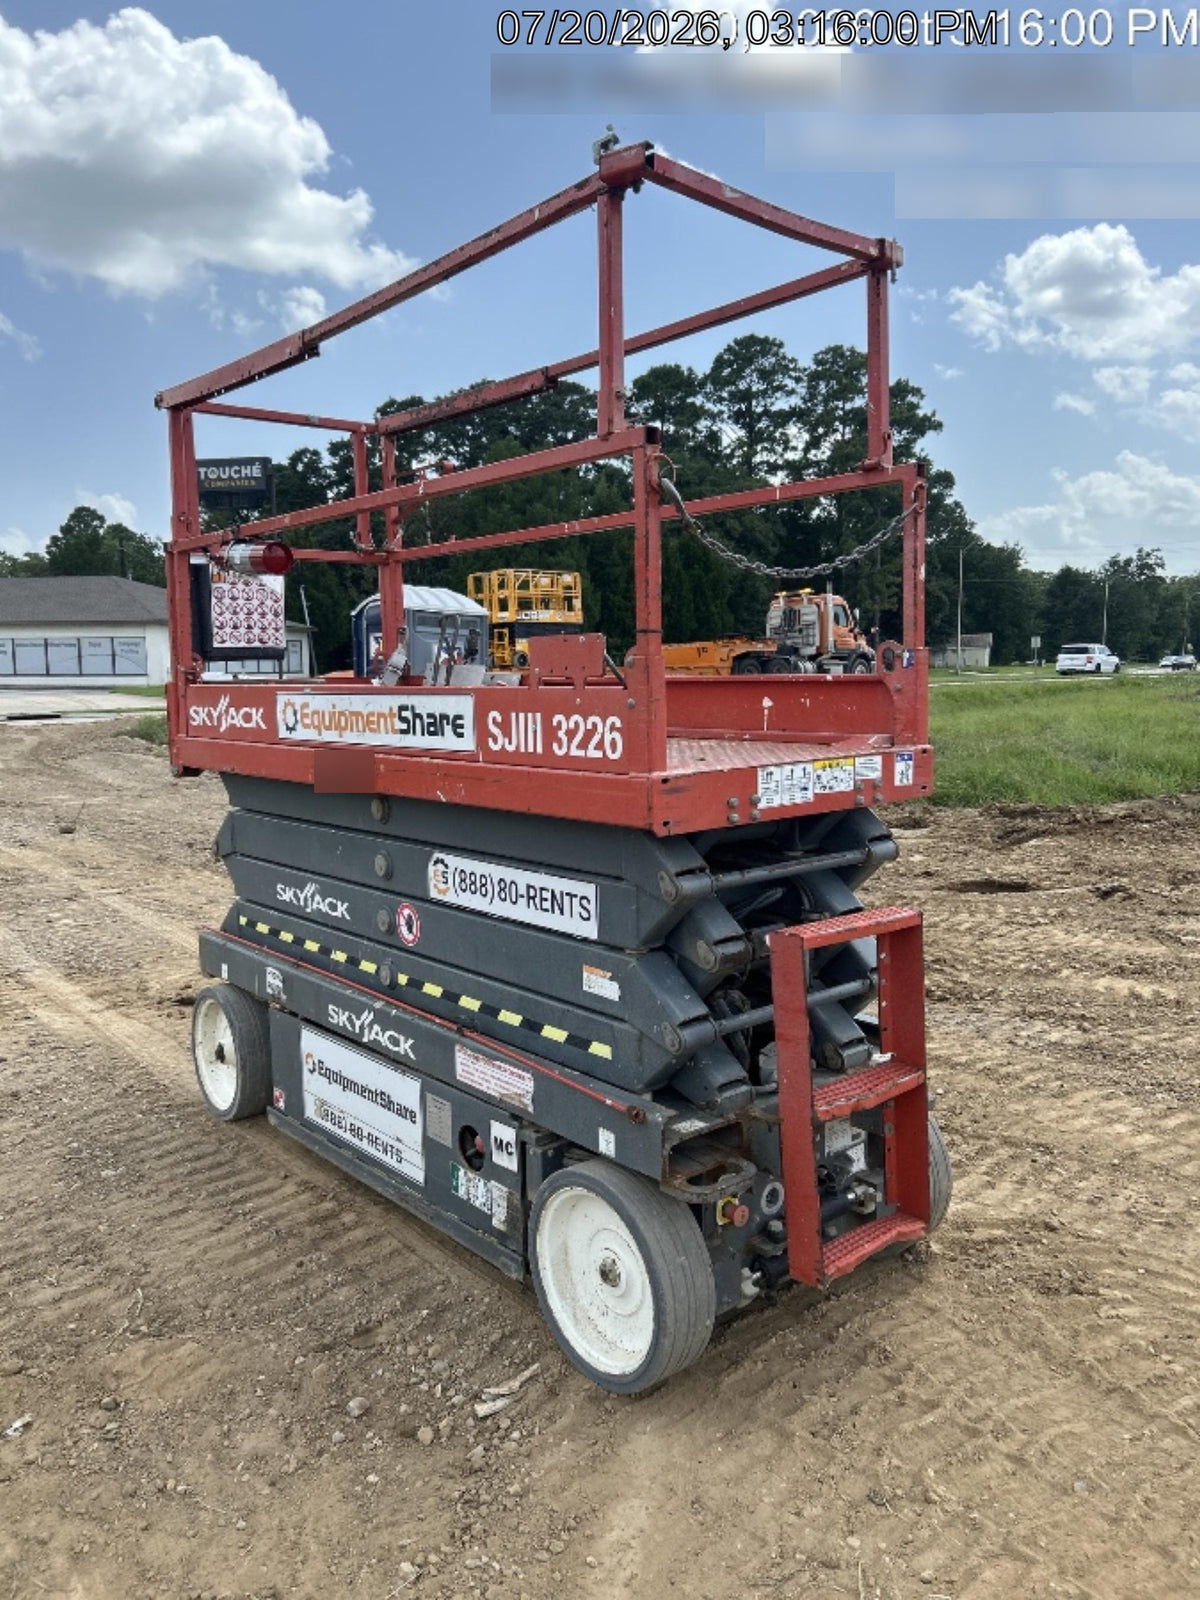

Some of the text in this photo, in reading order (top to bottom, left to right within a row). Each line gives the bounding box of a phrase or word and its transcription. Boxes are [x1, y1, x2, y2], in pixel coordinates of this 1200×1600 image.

[198, 462, 262, 480] TOUCHÉ
[189, 693, 267, 733] SKYJACK
[300, 702, 464, 738] EquipmentShare
[552, 714, 623, 760] 3226
[276, 881, 350, 919] SKYJACK
[327, 1004, 416, 1060] SKYJACK
[317, 1059, 417, 1125] EquipmentShare
